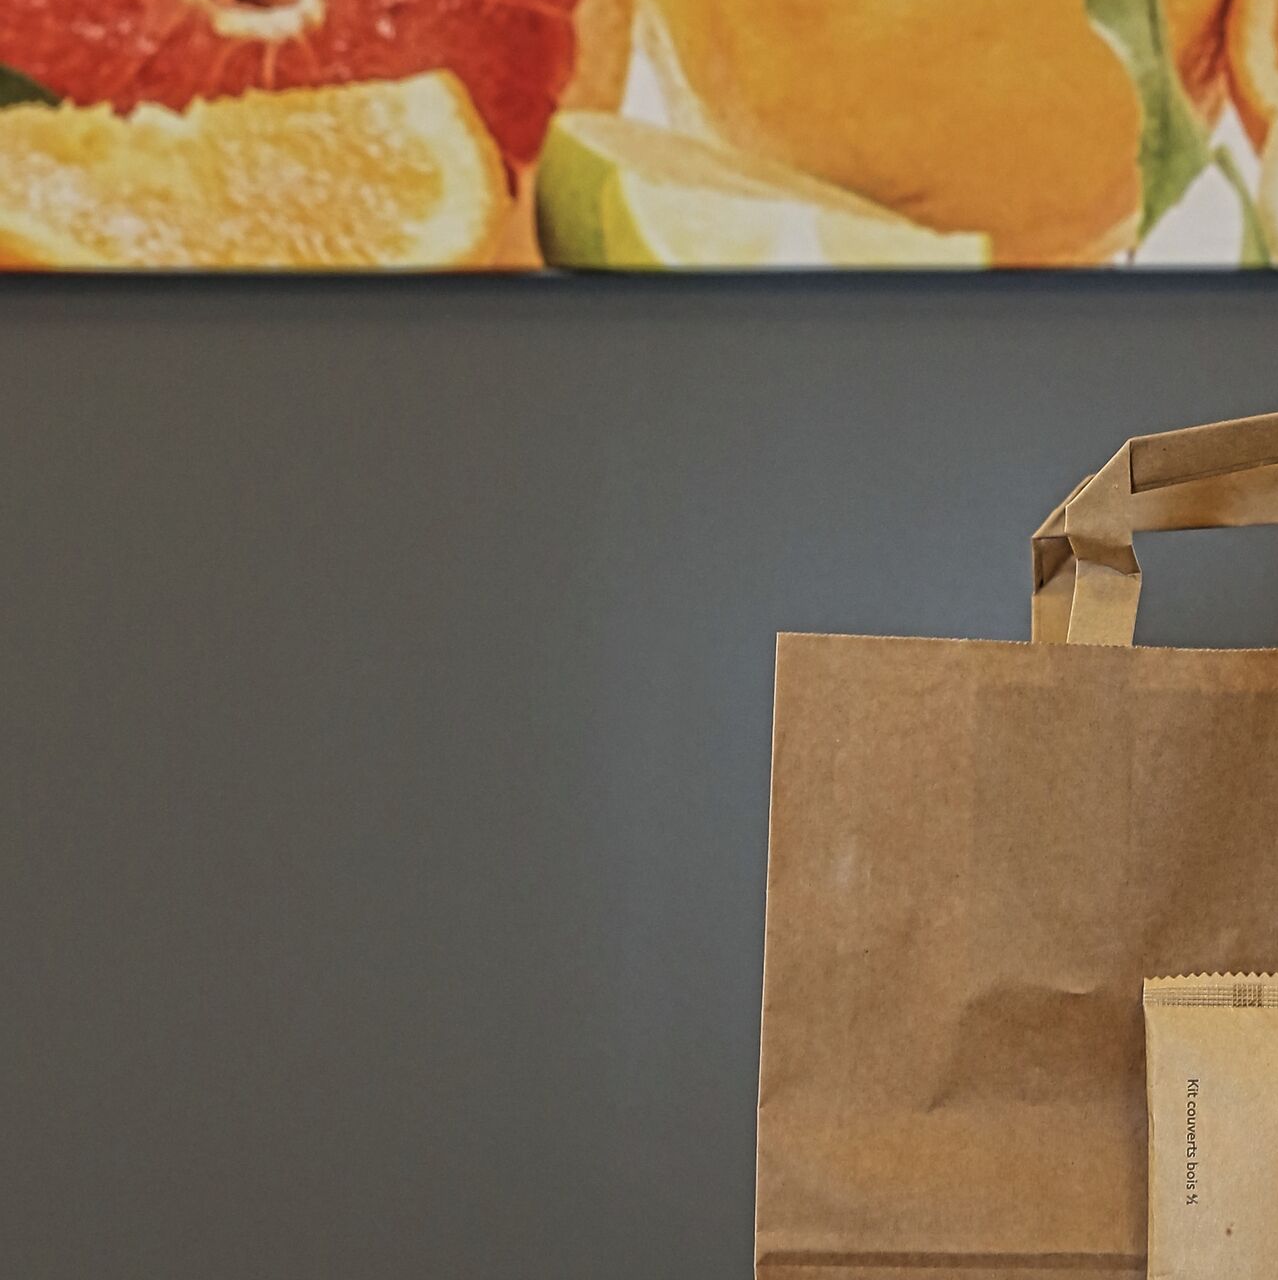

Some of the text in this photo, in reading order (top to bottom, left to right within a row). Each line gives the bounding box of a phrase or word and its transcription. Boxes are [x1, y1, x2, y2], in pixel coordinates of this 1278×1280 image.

[1187, 1079, 1199, 1098] Kit
[1186, 1101, 1197, 1158] couverts
[1186, 1162, 1198, 1190] bois
